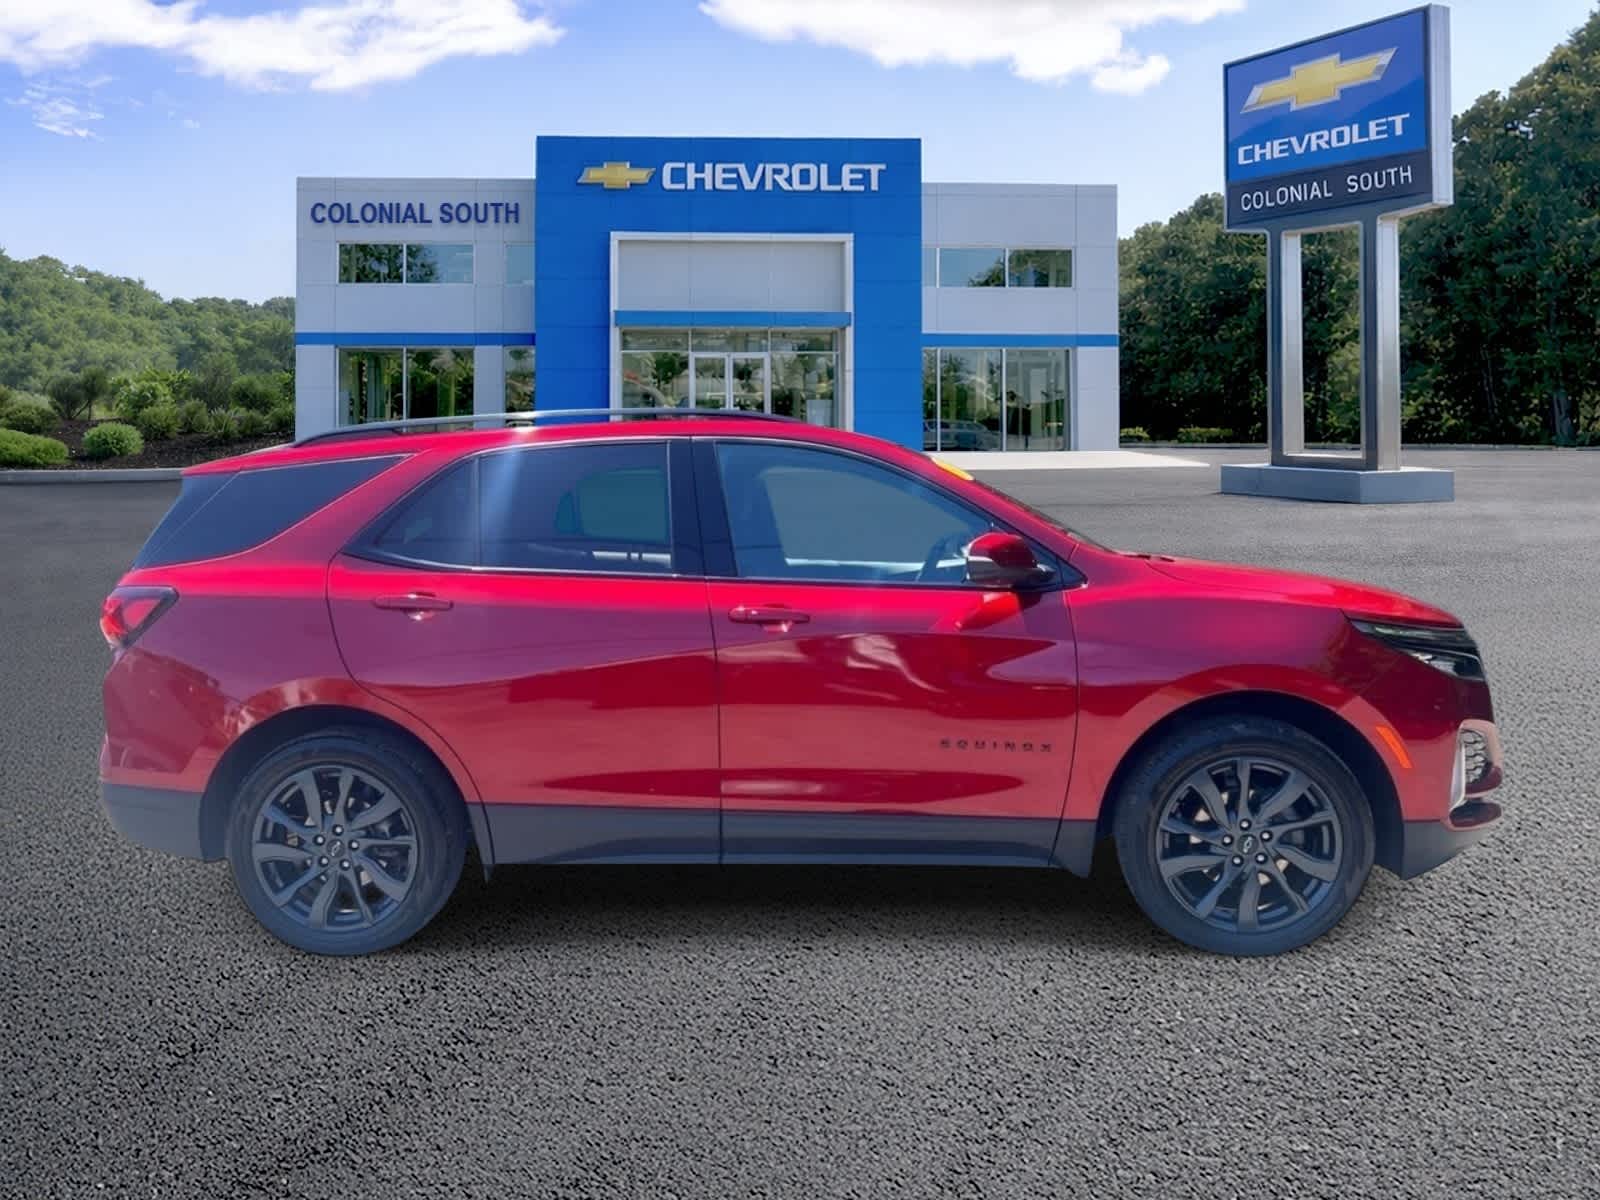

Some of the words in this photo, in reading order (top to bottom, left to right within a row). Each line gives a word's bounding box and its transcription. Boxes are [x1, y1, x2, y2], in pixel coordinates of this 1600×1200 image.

[1238, 112, 1410, 165] CHEVROLET
[661, 162, 886, 192] CHEVROLET
[1241, 179, 1333, 211] COLONIAL
[1346, 165, 1413, 193] SOUTH
[310, 202, 433, 225] COLONIAL
[439, 202, 520, 225] SOUTH
[939, 739, 1052, 753] EQUINOX
